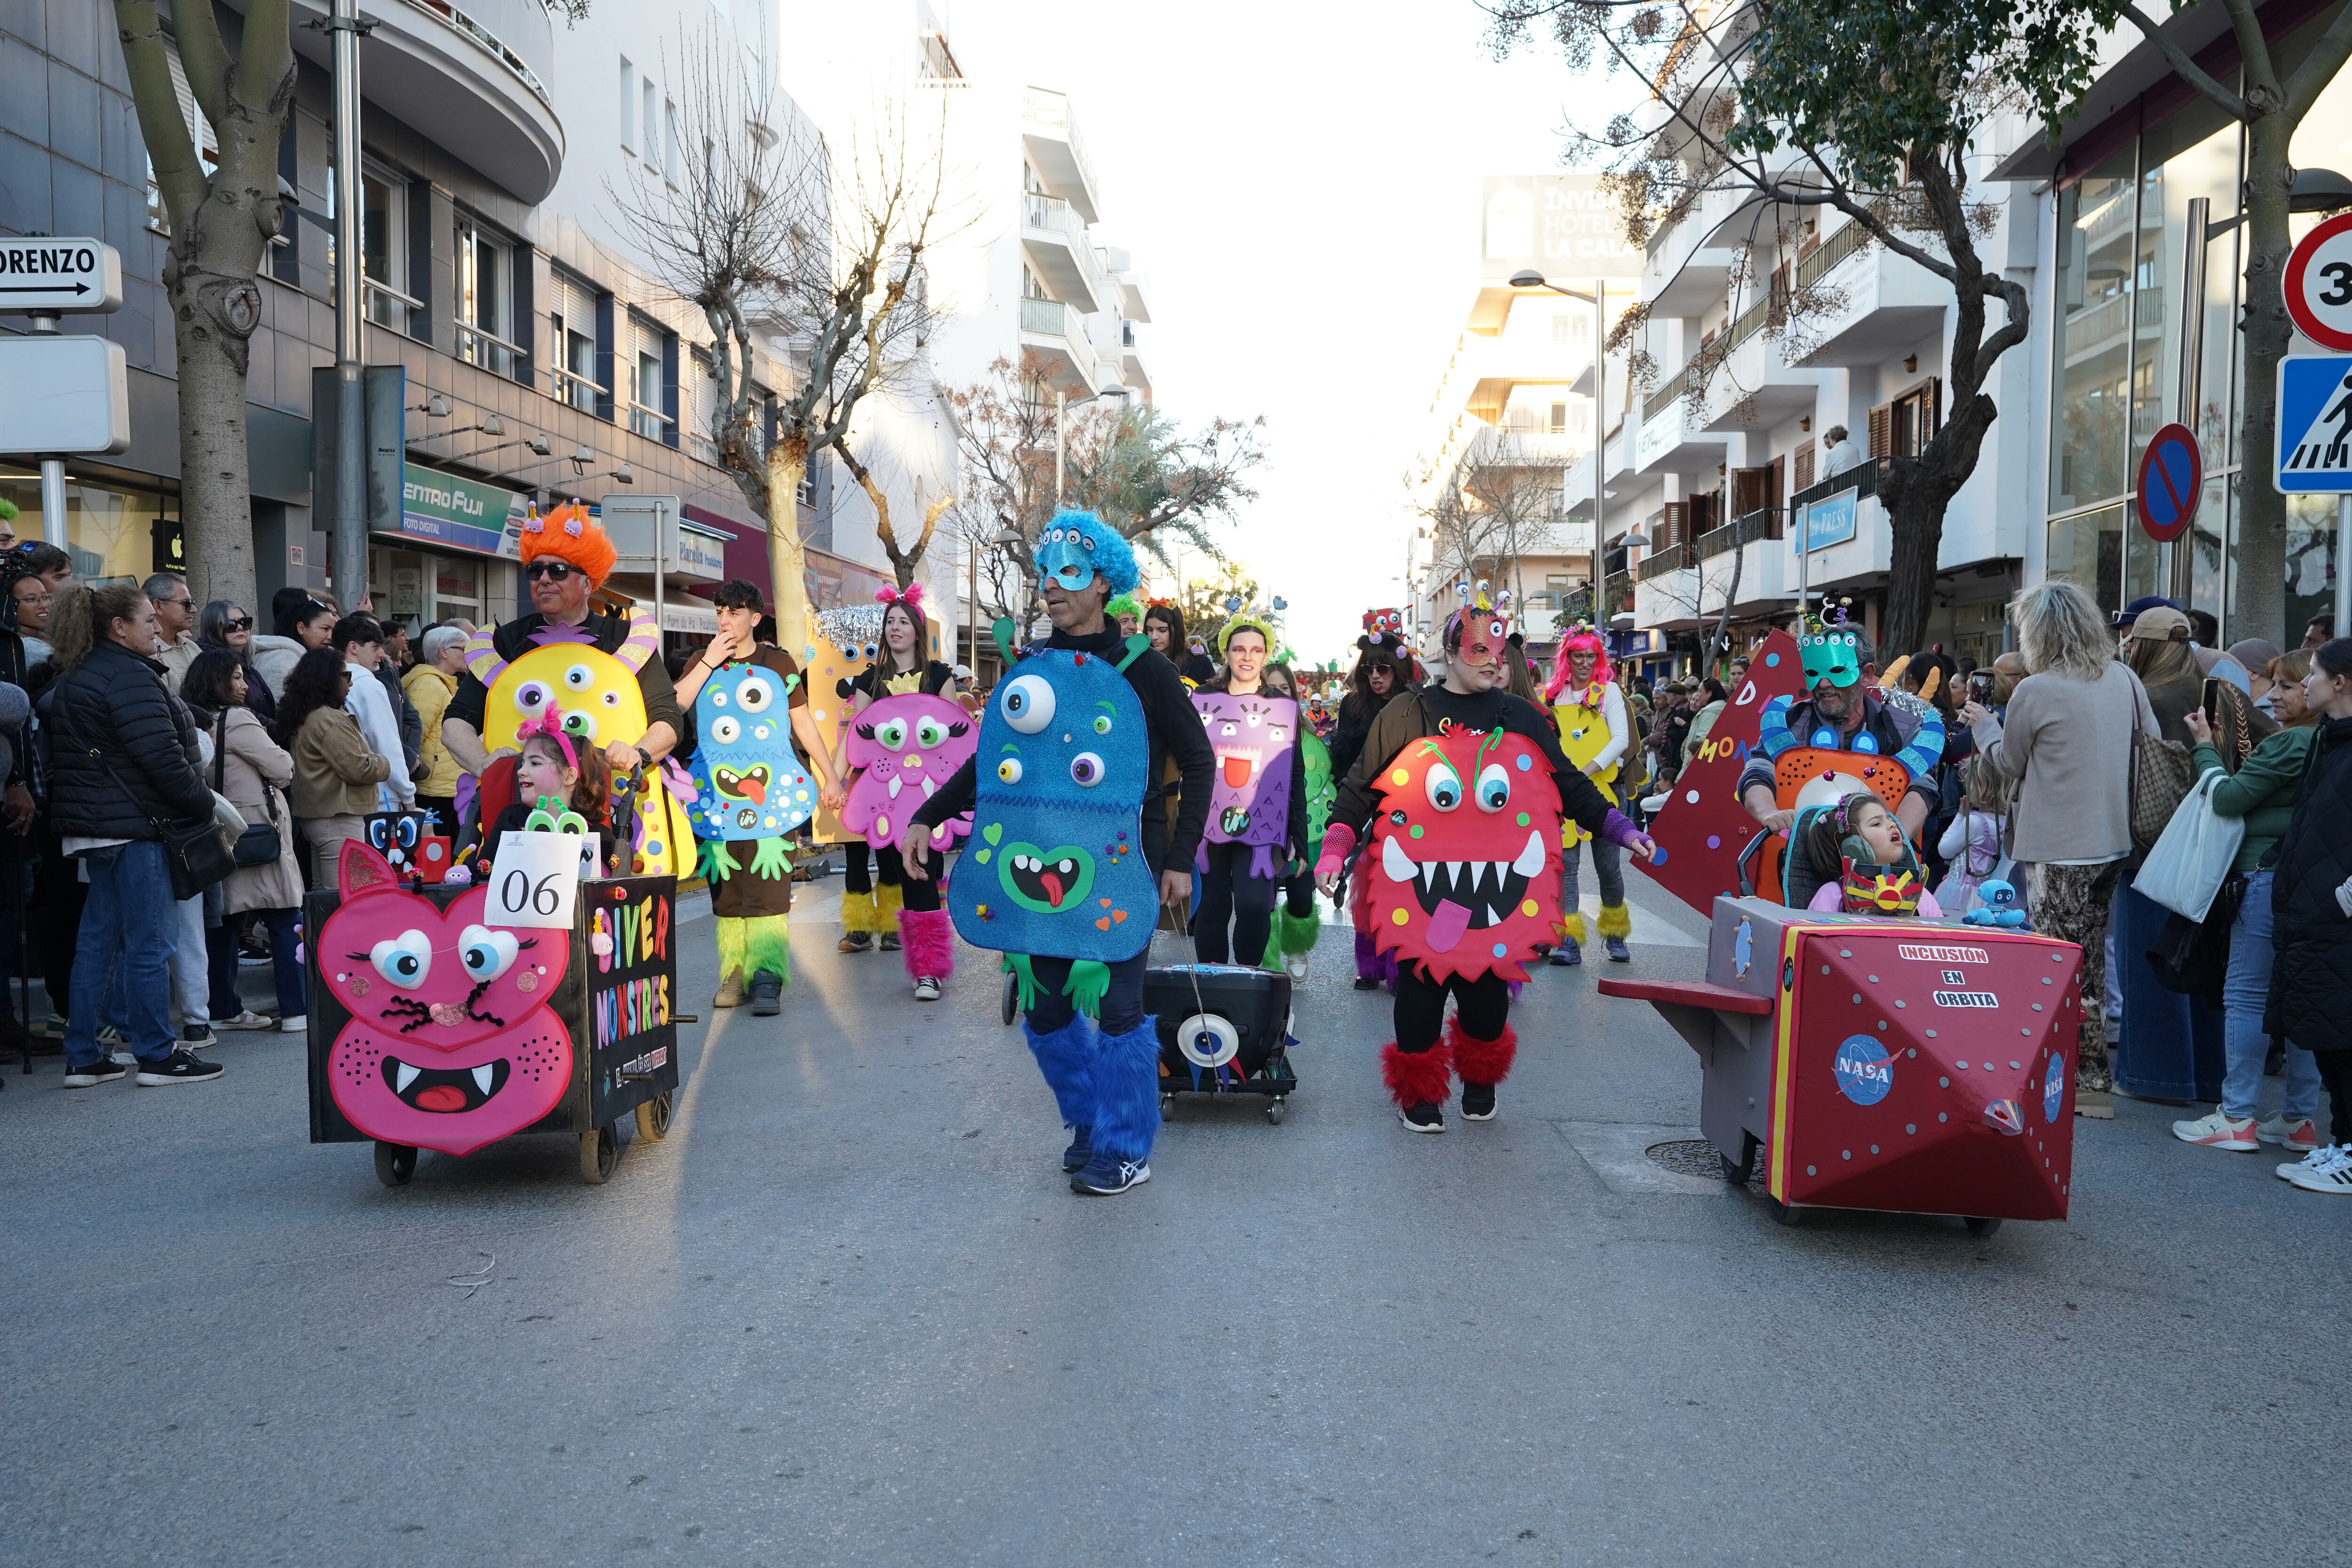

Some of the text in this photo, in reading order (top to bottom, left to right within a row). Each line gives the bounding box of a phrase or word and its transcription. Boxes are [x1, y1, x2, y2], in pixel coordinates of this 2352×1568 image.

[1545, 214, 1614, 234] HOTEL
[1545, 238, 1637, 258] LA CALA
[2319, 262, 2352, 306] 3
[404, 482, 484, 516] ENTRO FUJI
[404, 517, 440, 535] FOTO DIGITAL
[1821, 508, 1846, 534] PRESS
[437, 576, 472, 591] REPORTAJES
[667, 614, 679, 629] Forn
[681, 617, 687, 629] de
[689, 616, 695, 629] Pa
[1698, 736, 1756, 763] MON
[502, 870, 562, 915] 06
[597, 895, 668, 973] DIVER
[1900, 947, 1987, 963] INCLUSIÓN
[1943, 971, 1964, 984] EN
[1936, 991, 1997, 1006] ÓRBITA
[596, 974, 669, 1050] MONSTRES
[1839, 1057, 1889, 1083] NASA
[2045, 1077, 2063, 1099] NASA
